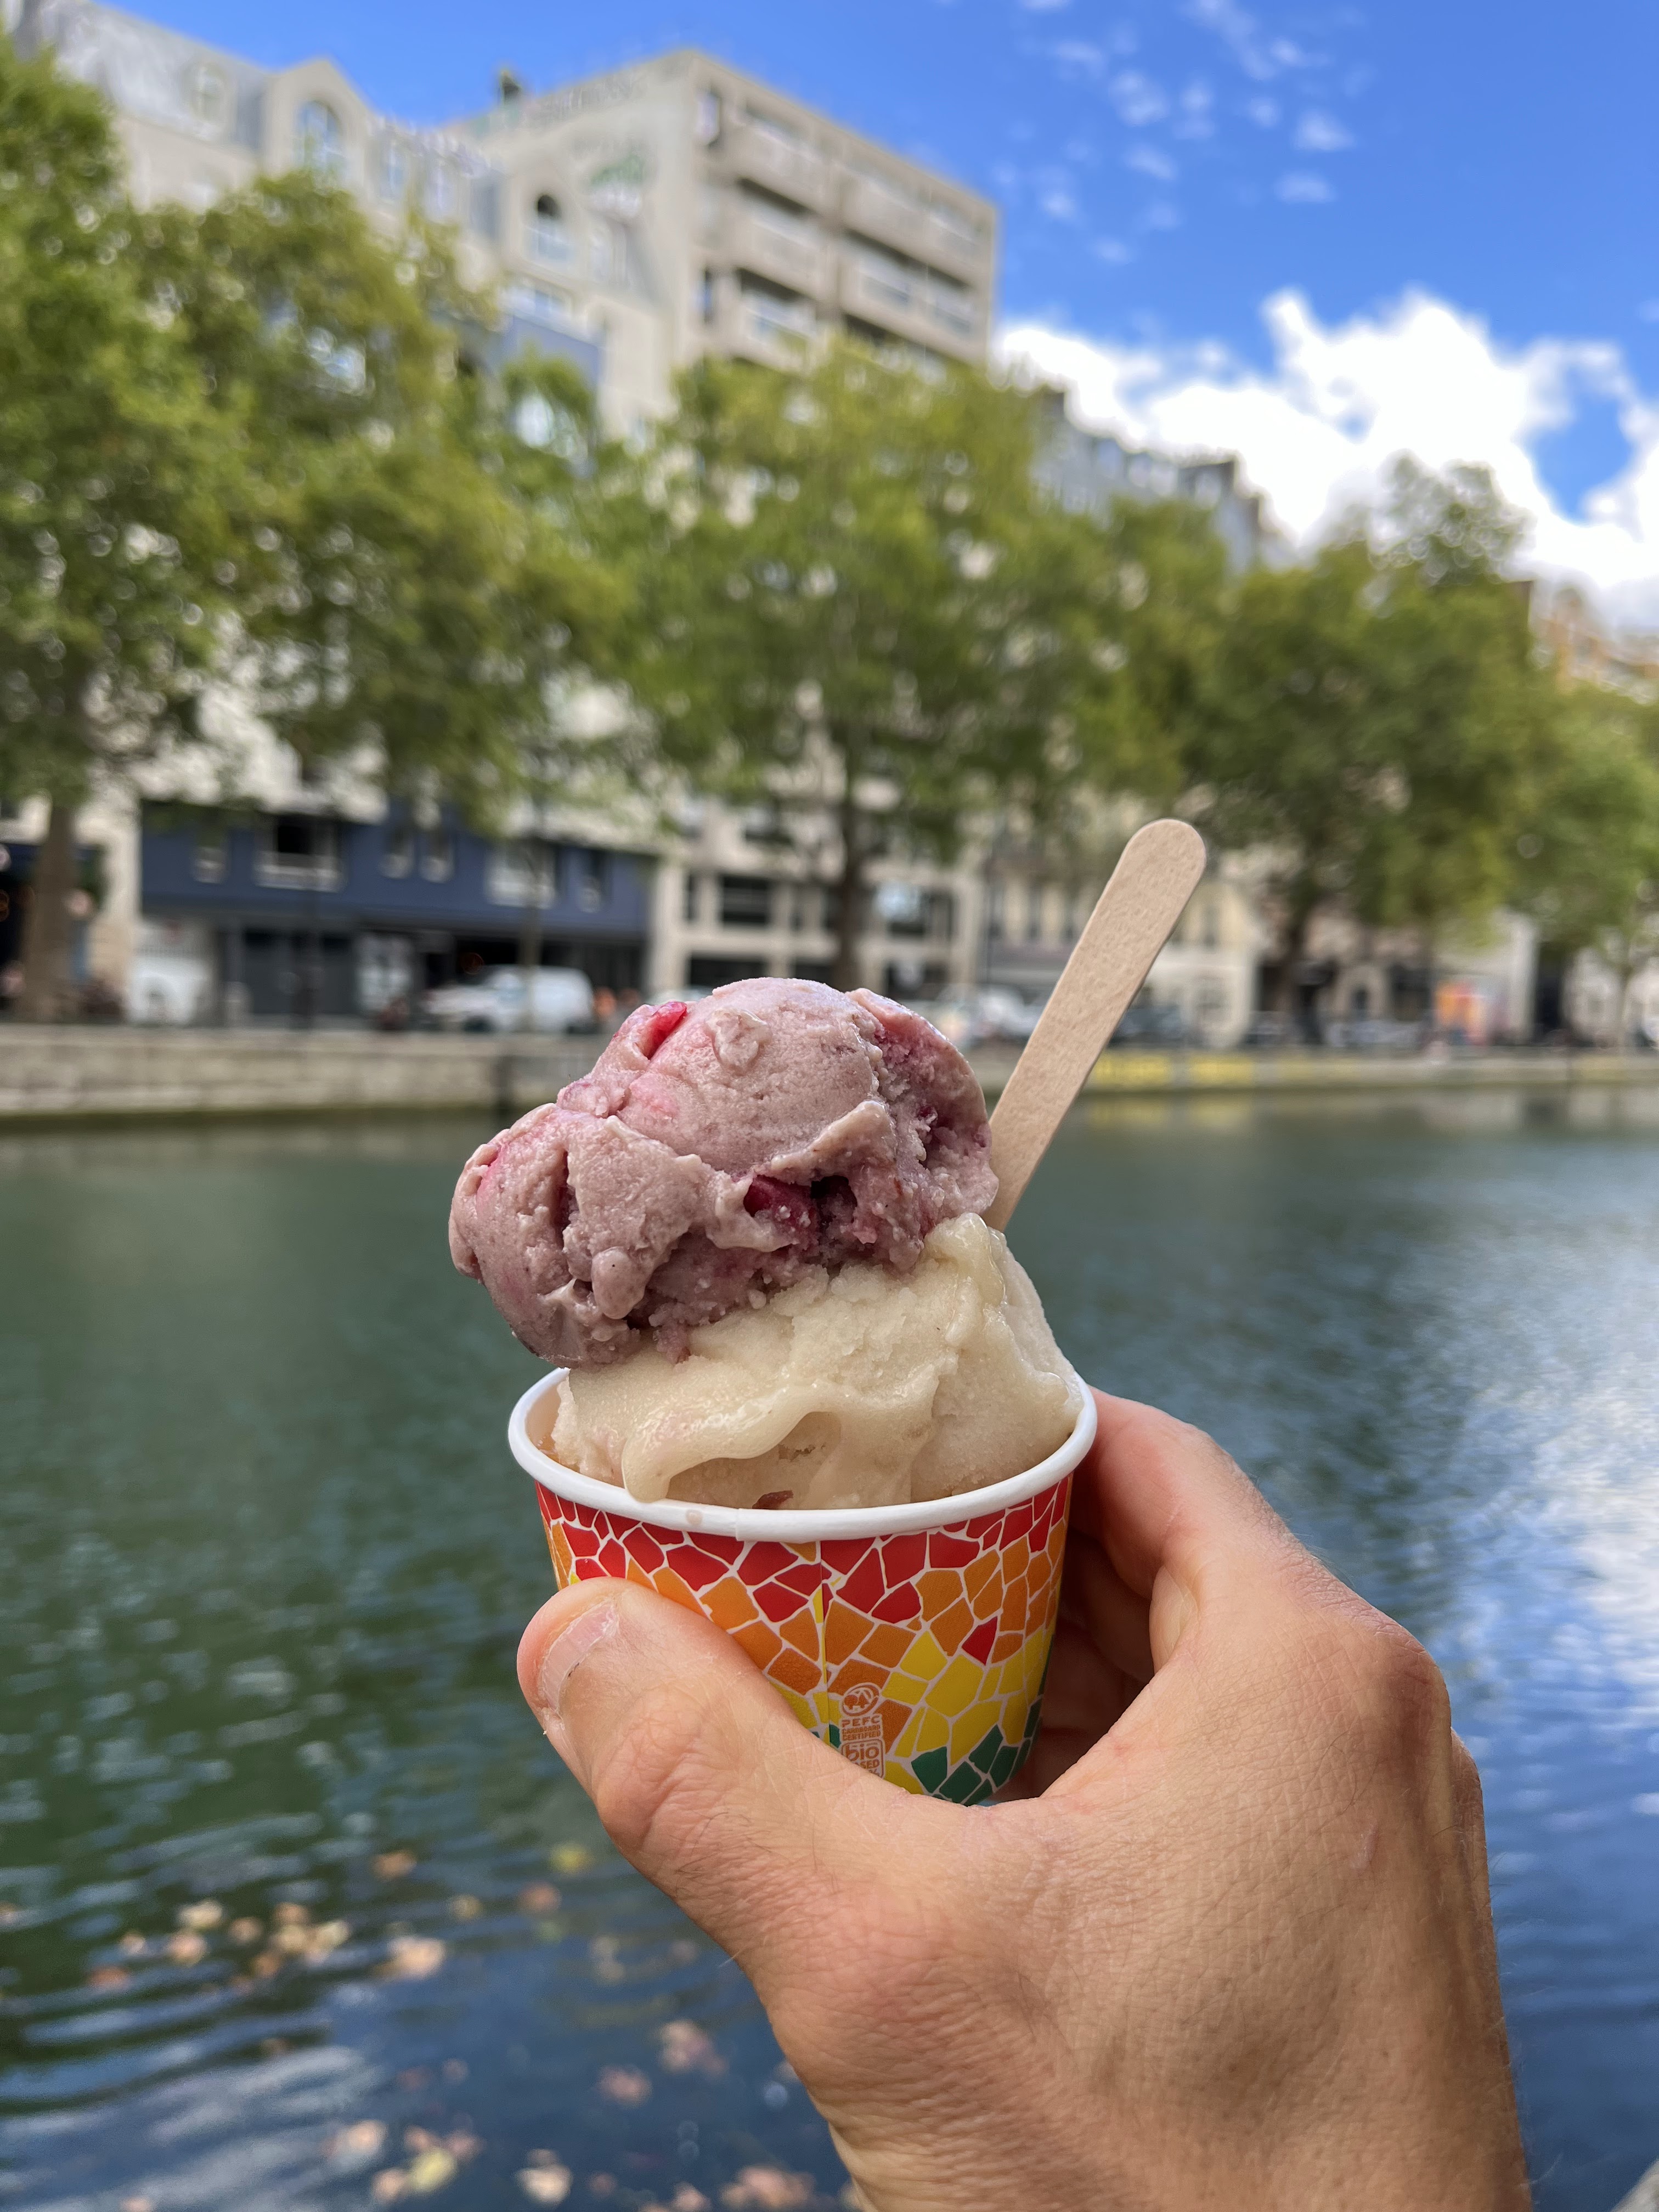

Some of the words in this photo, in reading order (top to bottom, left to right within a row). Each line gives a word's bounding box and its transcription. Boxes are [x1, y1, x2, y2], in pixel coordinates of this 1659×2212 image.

[842, 1715, 880, 1728] PEFC
[843, 1730, 881, 1741] CERTIFIED
[845, 1743, 879, 1762] bio
[855, 1759, 880, 1769] SED
